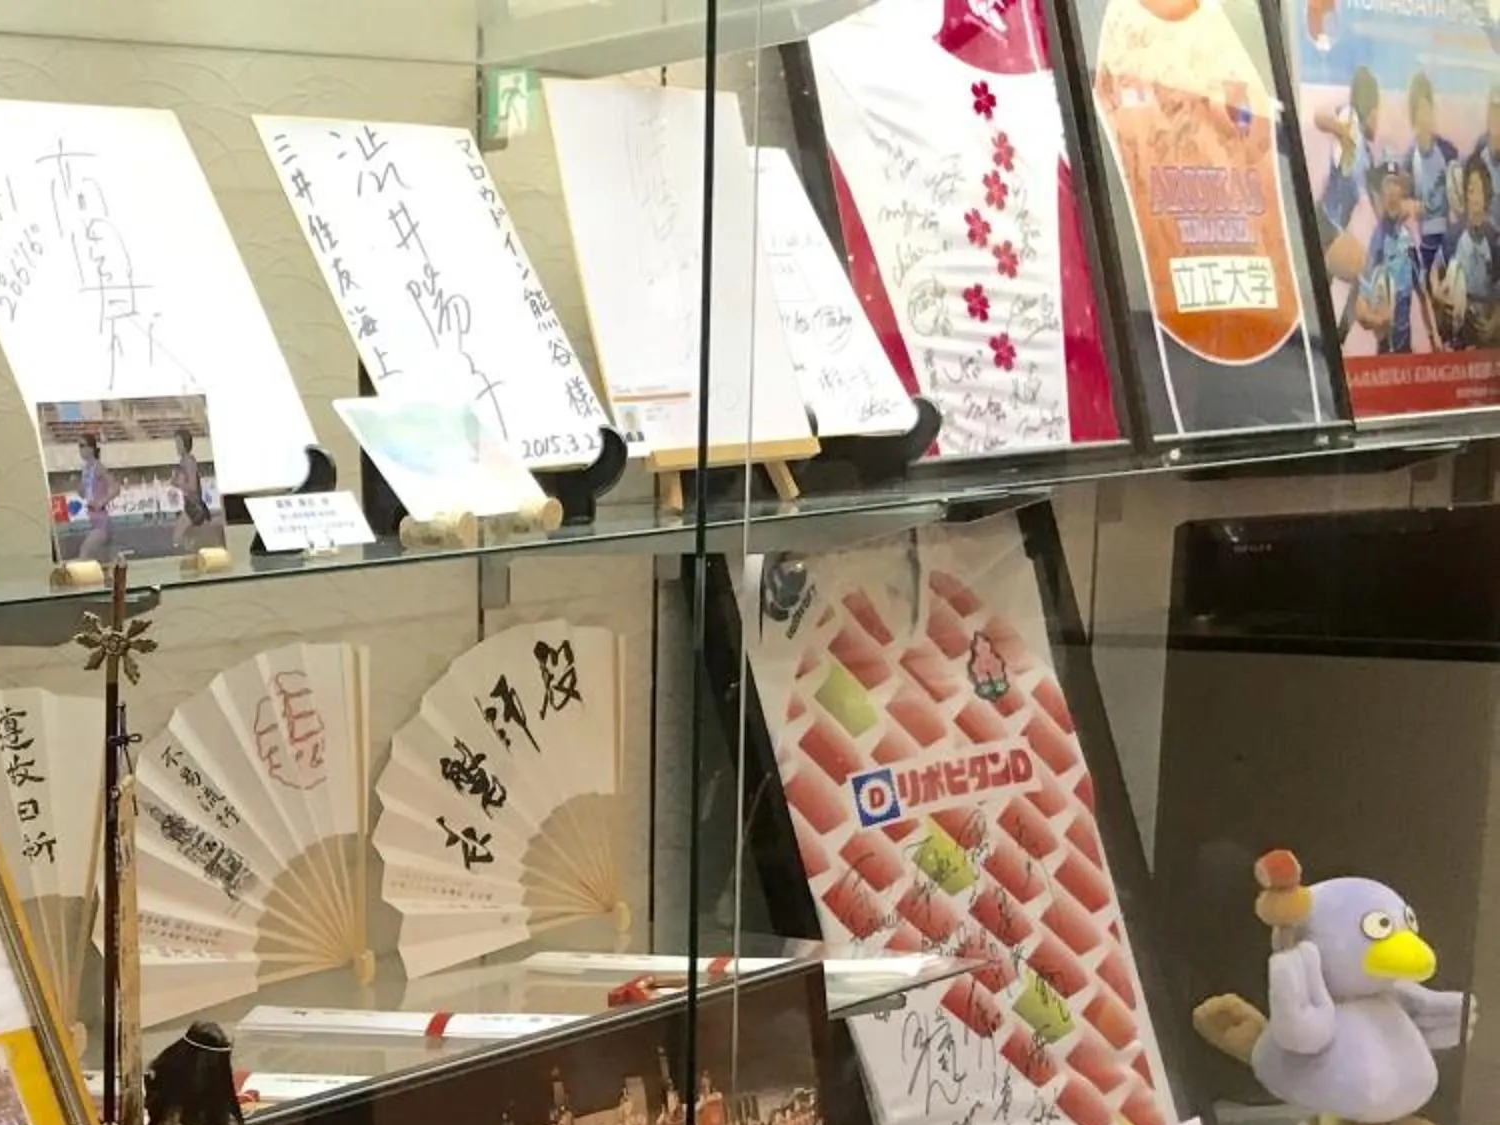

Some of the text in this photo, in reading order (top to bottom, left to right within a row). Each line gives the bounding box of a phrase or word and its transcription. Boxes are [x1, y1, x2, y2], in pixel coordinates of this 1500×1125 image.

[1173, 260, 1273, 308] 立正大学
[897, 749, 1034, 807] リポビタンD
